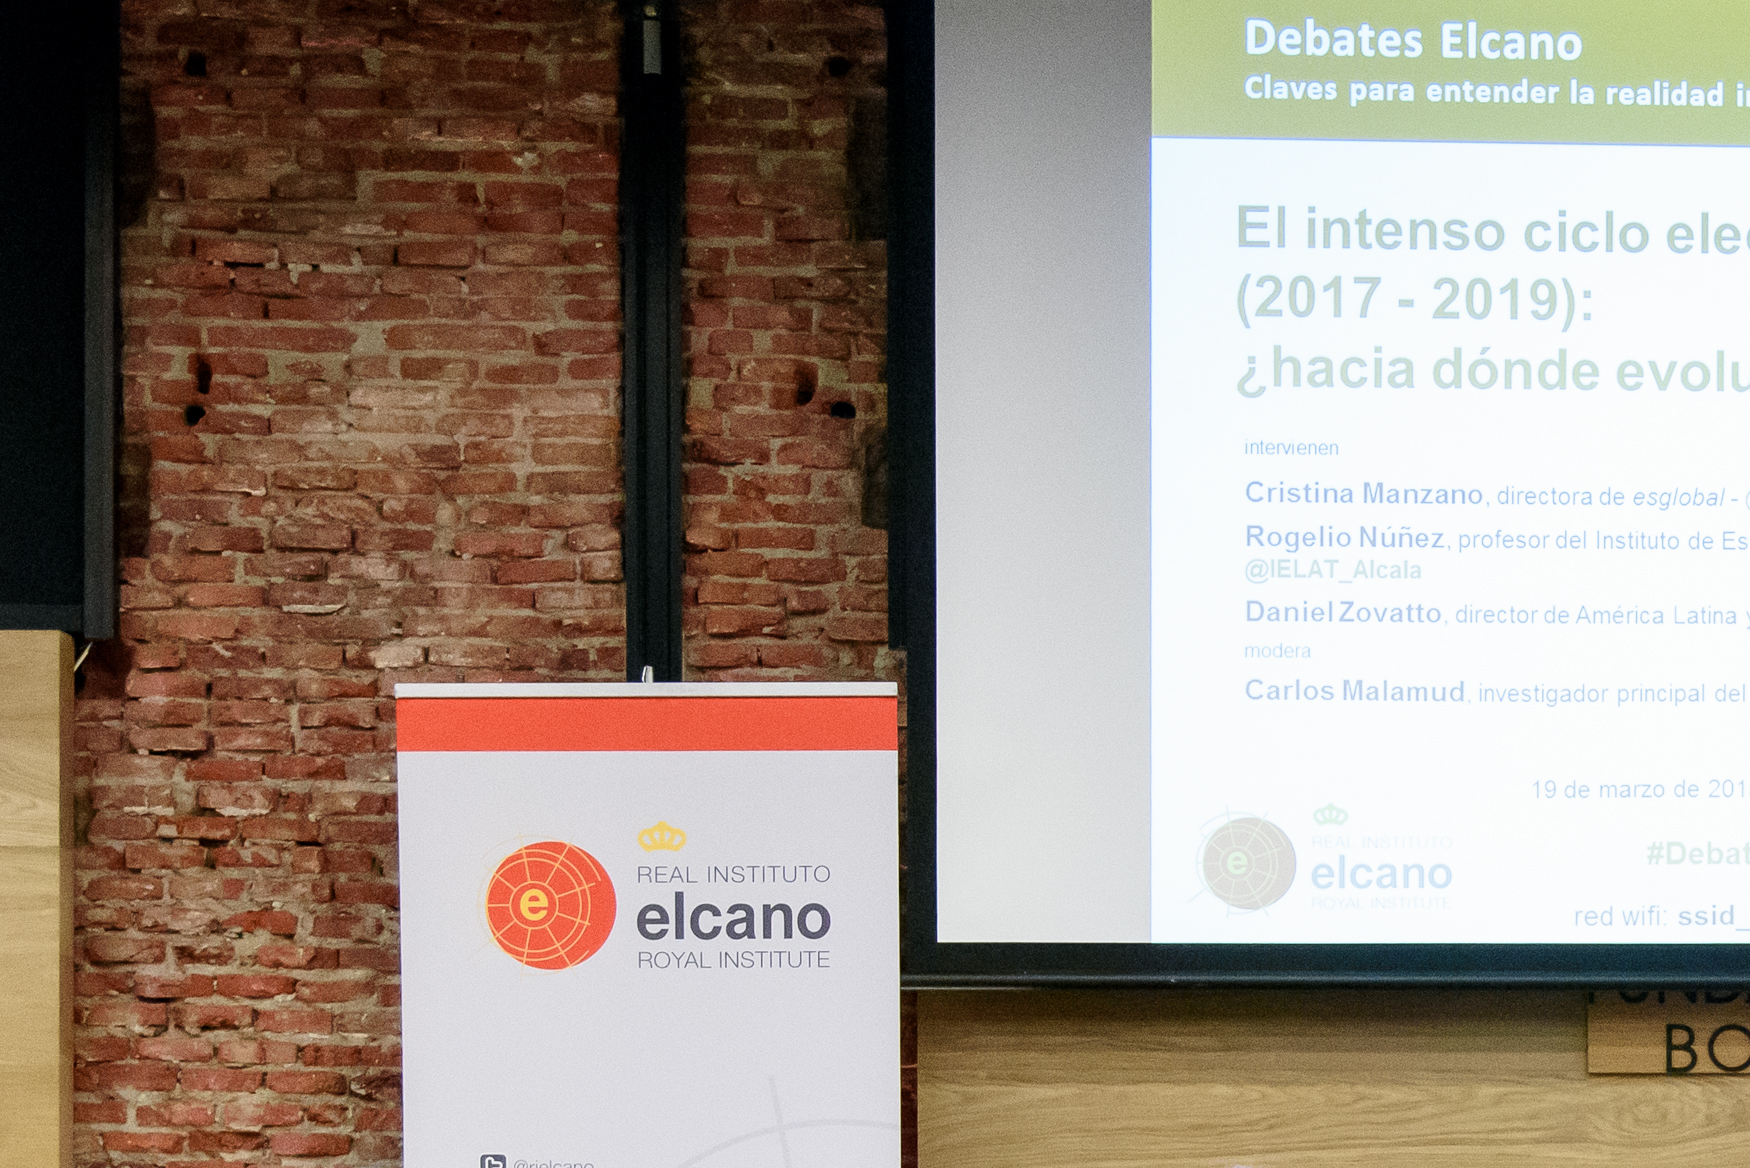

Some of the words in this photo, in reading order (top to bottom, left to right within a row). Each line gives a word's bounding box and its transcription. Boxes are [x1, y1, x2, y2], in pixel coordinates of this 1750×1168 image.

[1245, 16, 1423, 58] Debates
[1440, 19, 1583, 61] Elcano
[1243, 72, 1337, 100] Claves
[1349, 80, 1415, 107] para
[1425, 77, 1560, 104] entender
[1569, 77, 1595, 104] la
[1605, 79, 1725, 107] realidad
[1238, 205, 1286, 248] El
[1307, 205, 1505, 252] intenso
[1524, 209, 1650, 254] ciclo
[1237, 273, 1382, 329] (2017
[1432, 277, 1592, 333] 2019):
[1237, 344, 1415, 399] ¿hacia
[1432, 346, 1599, 391] dónde
[1245, 440, 1339, 455] intervienen
[1246, 481, 1353, 503] Cristina
[1363, 482, 1489, 506] Manzano,
[1497, 486, 1593, 506] directora
[1599, 487, 1625, 506] de
[1633, 487, 1725, 511] esglobal
[1246, 525, 1351, 553] Rogelio
[1360, 526, 1450, 549] Núñez,
[1459, 529, 1550, 553] profesor
[1555, 530, 1587, 549] del
[1596, 530, 1680, 550] Instituto
[1688, 531, 1714, 550] de
[1245, 558, 1422, 585] @IELAT_Alcala
[1246, 600, 1333, 622] Daniel
[1339, 600, 1449, 626] Zovatto,
[1455, 605, 1538, 624] director
[1544, 605, 1570, 624] de
[1575, 605, 1664, 625] América
[1674, 606, 1737, 625] Latina
[1244, 643, 1311, 658] modera
[1245, 679, 1334, 701] Carlos
[1342, 679, 1471, 704] Malamud,
[1479, 683, 1609, 708] investigador
[1617, 683, 1705, 707] principal
[1714, 684, 1746, 703] del
[1533, 779, 1557, 799] 19
[1564, 780, 1590, 799] de
[1599, 783, 1665, 798] marzo
[1673, 779, 1699, 798] de
[1312, 835, 1357, 848] REAL
[1361, 836, 1453, 849] INSTITUTO
[637, 866, 697, 883] REAL
[707, 865, 831, 883] INSTITUTO
[1311, 854, 1452, 890] elcano
[637, 891, 831, 940] elcano
[1311, 896, 1363, 911] ROYAL
[1370, 896, 1451, 910] INSTITUTE
[1575, 906, 1613, 926] red
[1622, 905, 1666, 926] wifi:
[638, 951, 711, 969] ROYAL
[719, 950, 830, 969] INSTITUTE
